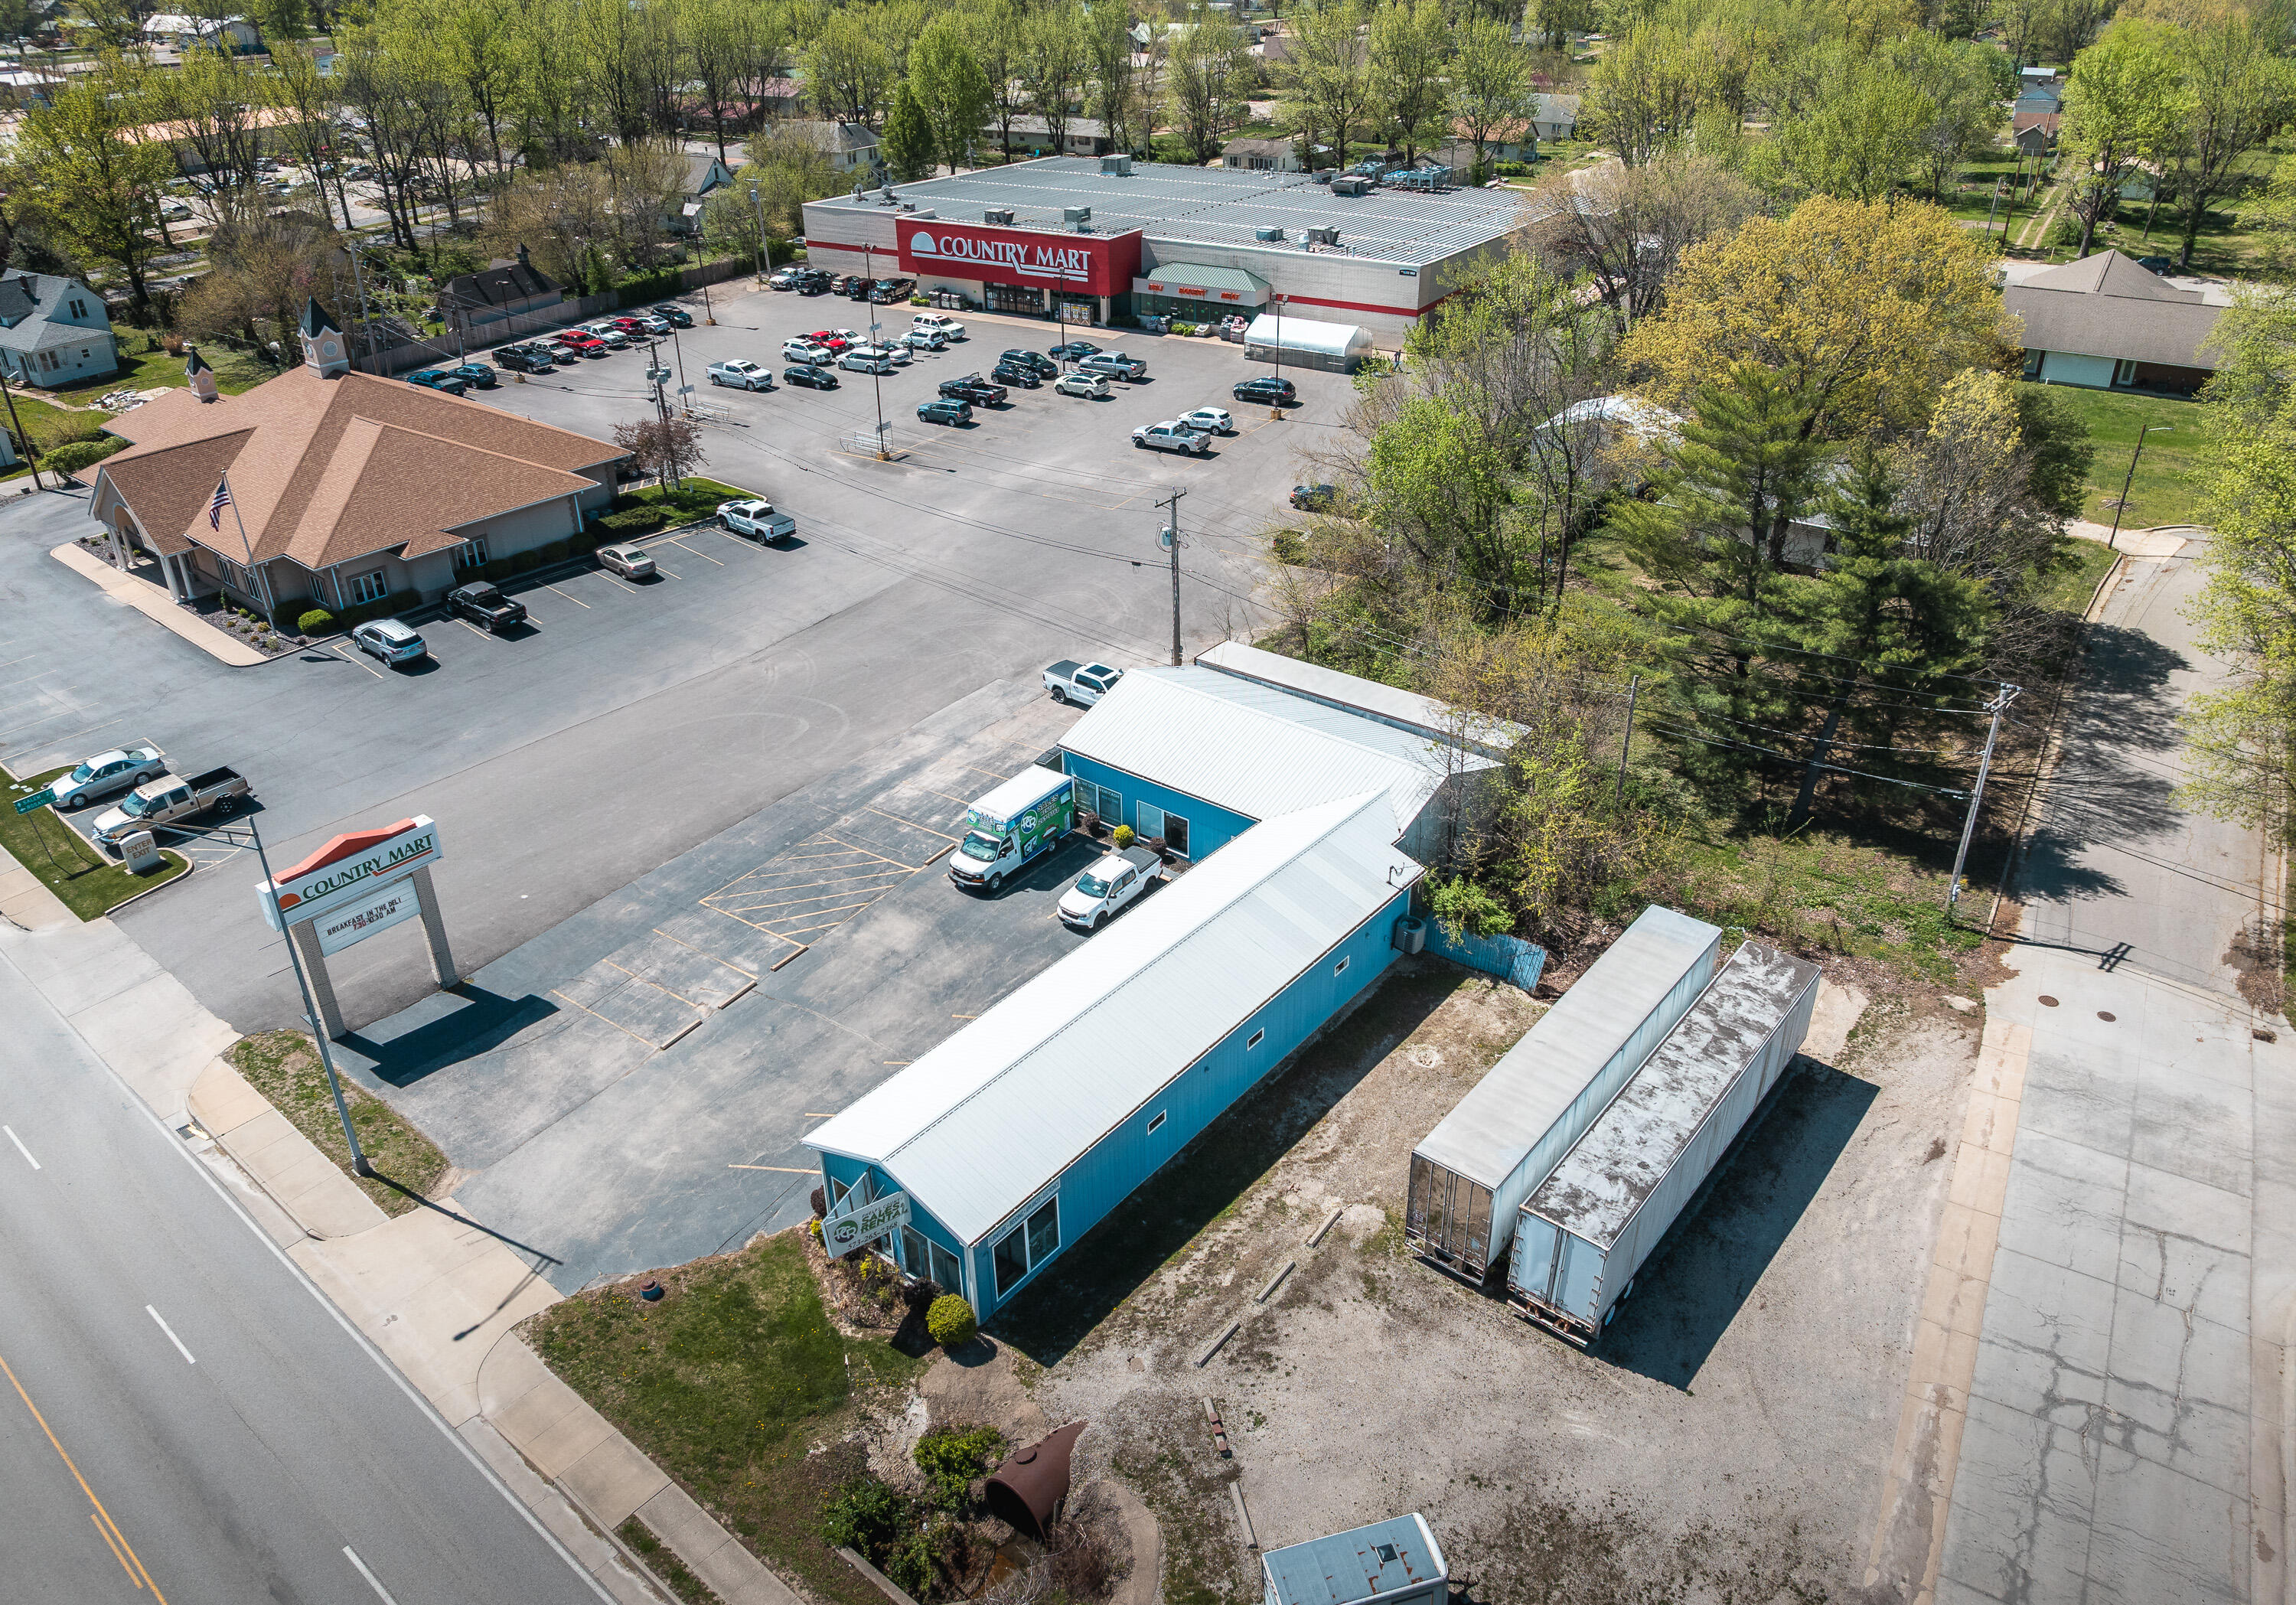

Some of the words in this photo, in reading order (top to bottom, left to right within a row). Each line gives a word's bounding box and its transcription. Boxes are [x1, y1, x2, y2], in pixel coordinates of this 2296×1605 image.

[940, 236, 1029, 265] COUNTRY
[1036, 246, 1091, 270] MART
[23, 794, 41, 804] SALEM
[26, 800, 46, 809] ROSATI
[1036, 793, 1058, 812] SALES
[126, 839, 152, 854] ENTER
[132, 847, 150, 859] EXIT
[302, 856, 381, 899] COUNTRY
[389, 833, 432, 863] MART
[327, 914, 364, 935] BREAKFAST
[367, 909, 374, 918] IN
[375, 903, 387, 914] THE
[388, 897, 403, 907] DELI
[386, 906, 396, 916] AM
[861, 1209, 908, 1233] RENTAL
[862, 1202, 900, 1222] SALES
[847, 1221, 898, 1249] 573-265-7368
[989, 1225, 1006, 1244] FURNITURE
[1009, 1212, 1024, 1227] BEDDING
